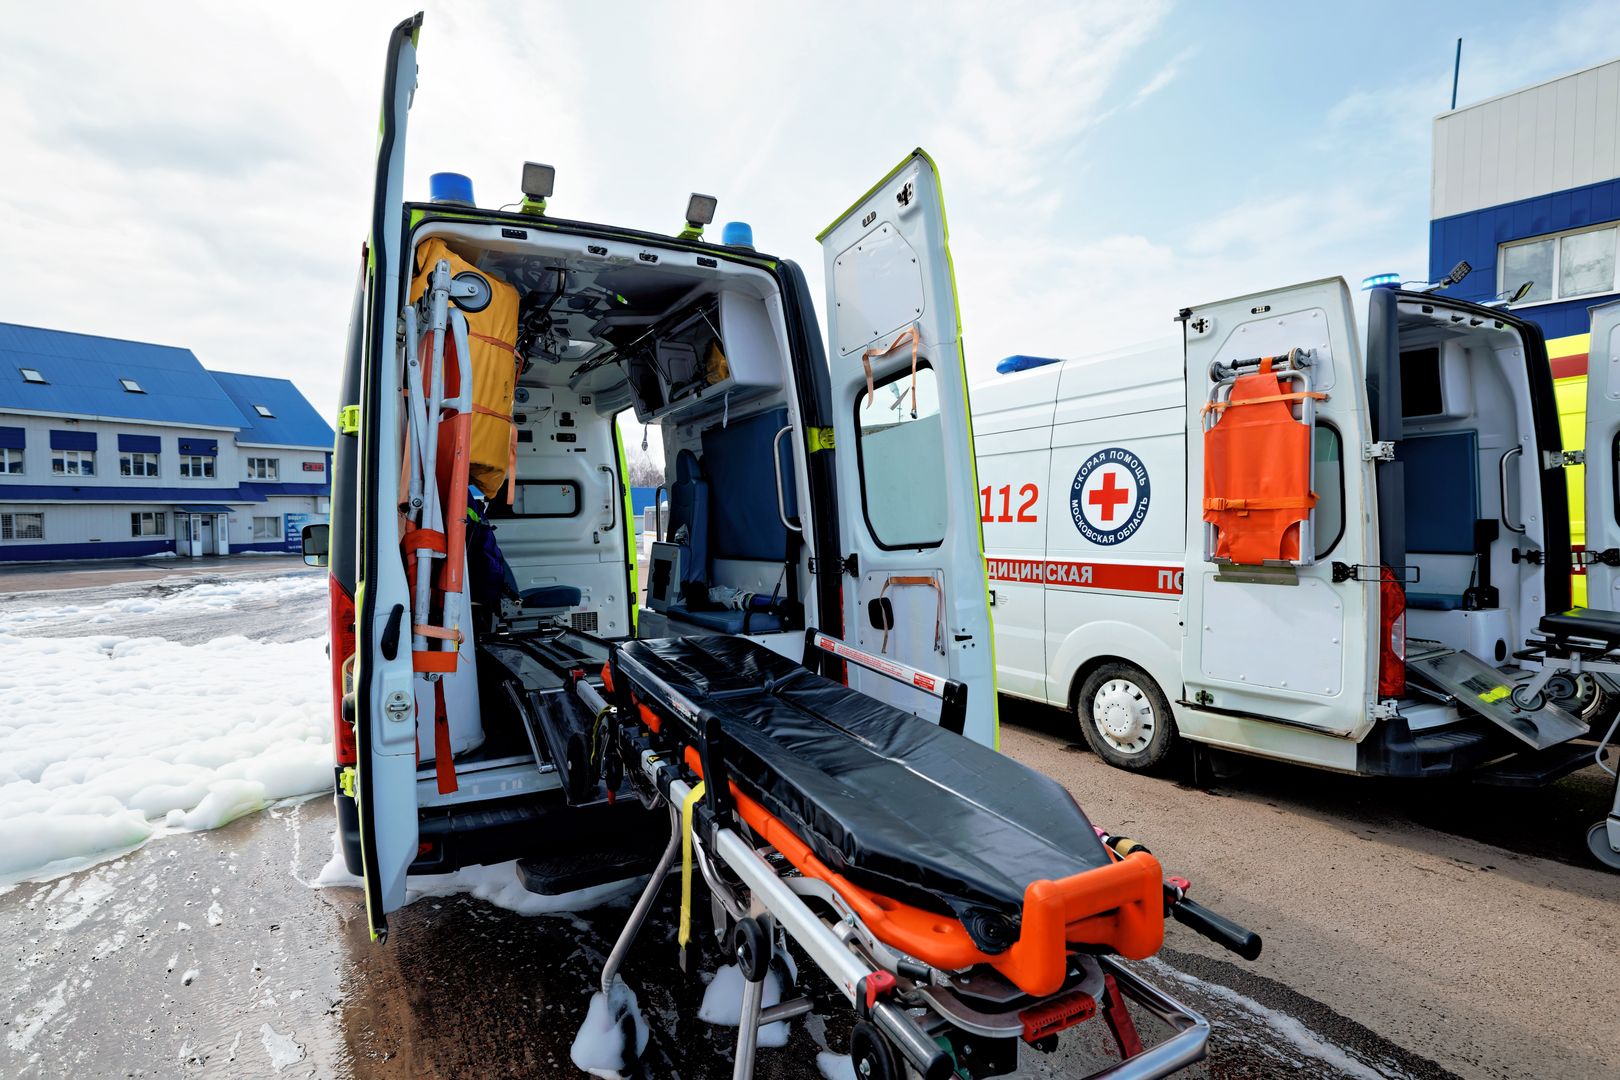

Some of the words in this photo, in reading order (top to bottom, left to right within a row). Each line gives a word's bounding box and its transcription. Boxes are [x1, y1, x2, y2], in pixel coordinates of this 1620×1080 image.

[1074, 453, 1106, 490] СКОРАЯ
[1109, 450, 1147, 486] ПОМОЩЬ
[981, 483, 1039, 522] 112
[1072, 499, 1115, 543] МОСКОВСКАЯ
[1117, 497, 1148, 540] ОБЛАСТЬ
